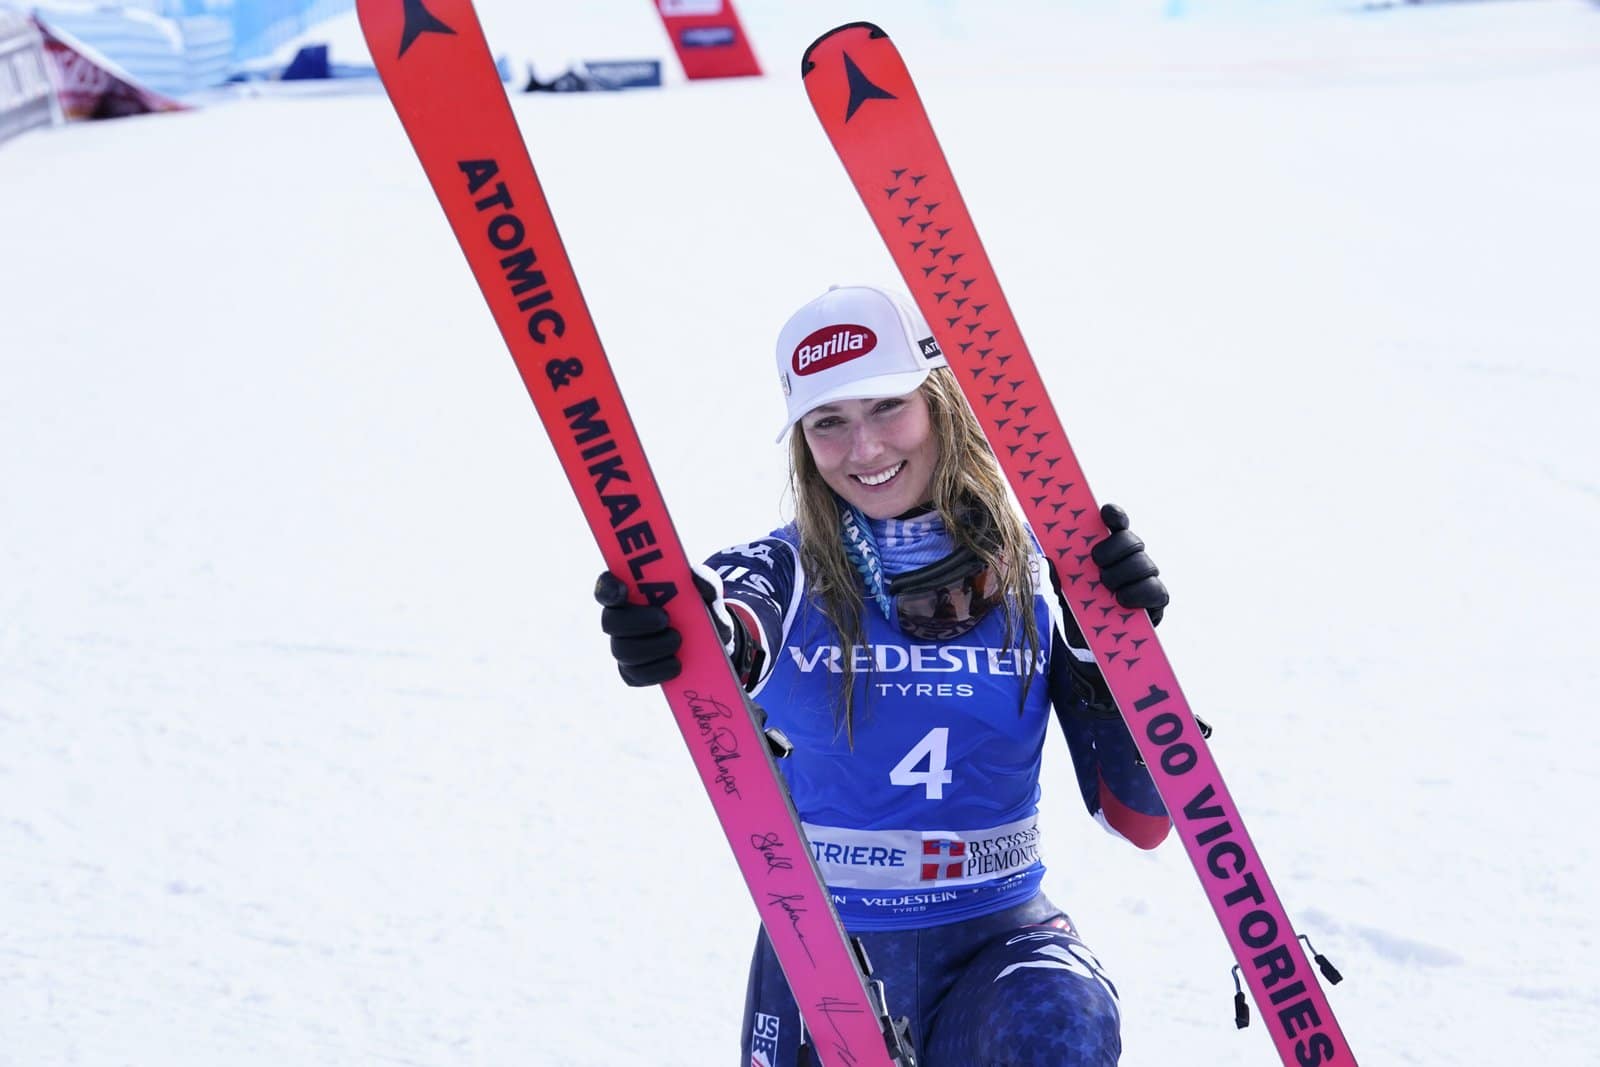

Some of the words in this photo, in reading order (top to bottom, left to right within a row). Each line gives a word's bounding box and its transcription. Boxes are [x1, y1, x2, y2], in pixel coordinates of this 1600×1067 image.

[457, 159, 566, 345] ATOMIC
[798, 331, 865, 371] Barilla
[545, 356, 584, 392] &
[563, 397, 679, 608] MIKAELA
[788, 644, 1046, 676] VREDESTEIN
[875, 683, 974, 697] TYRES
[889, 727, 953, 800] 4
[807, 840, 907, 867] TRIERE
[1133, 684, 1198, 777] 100
[1183, 784, 1335, 1067] VICTORIES
[861, 891, 957, 907] VREDESTEIN
[755, 1015, 778, 1039] US
